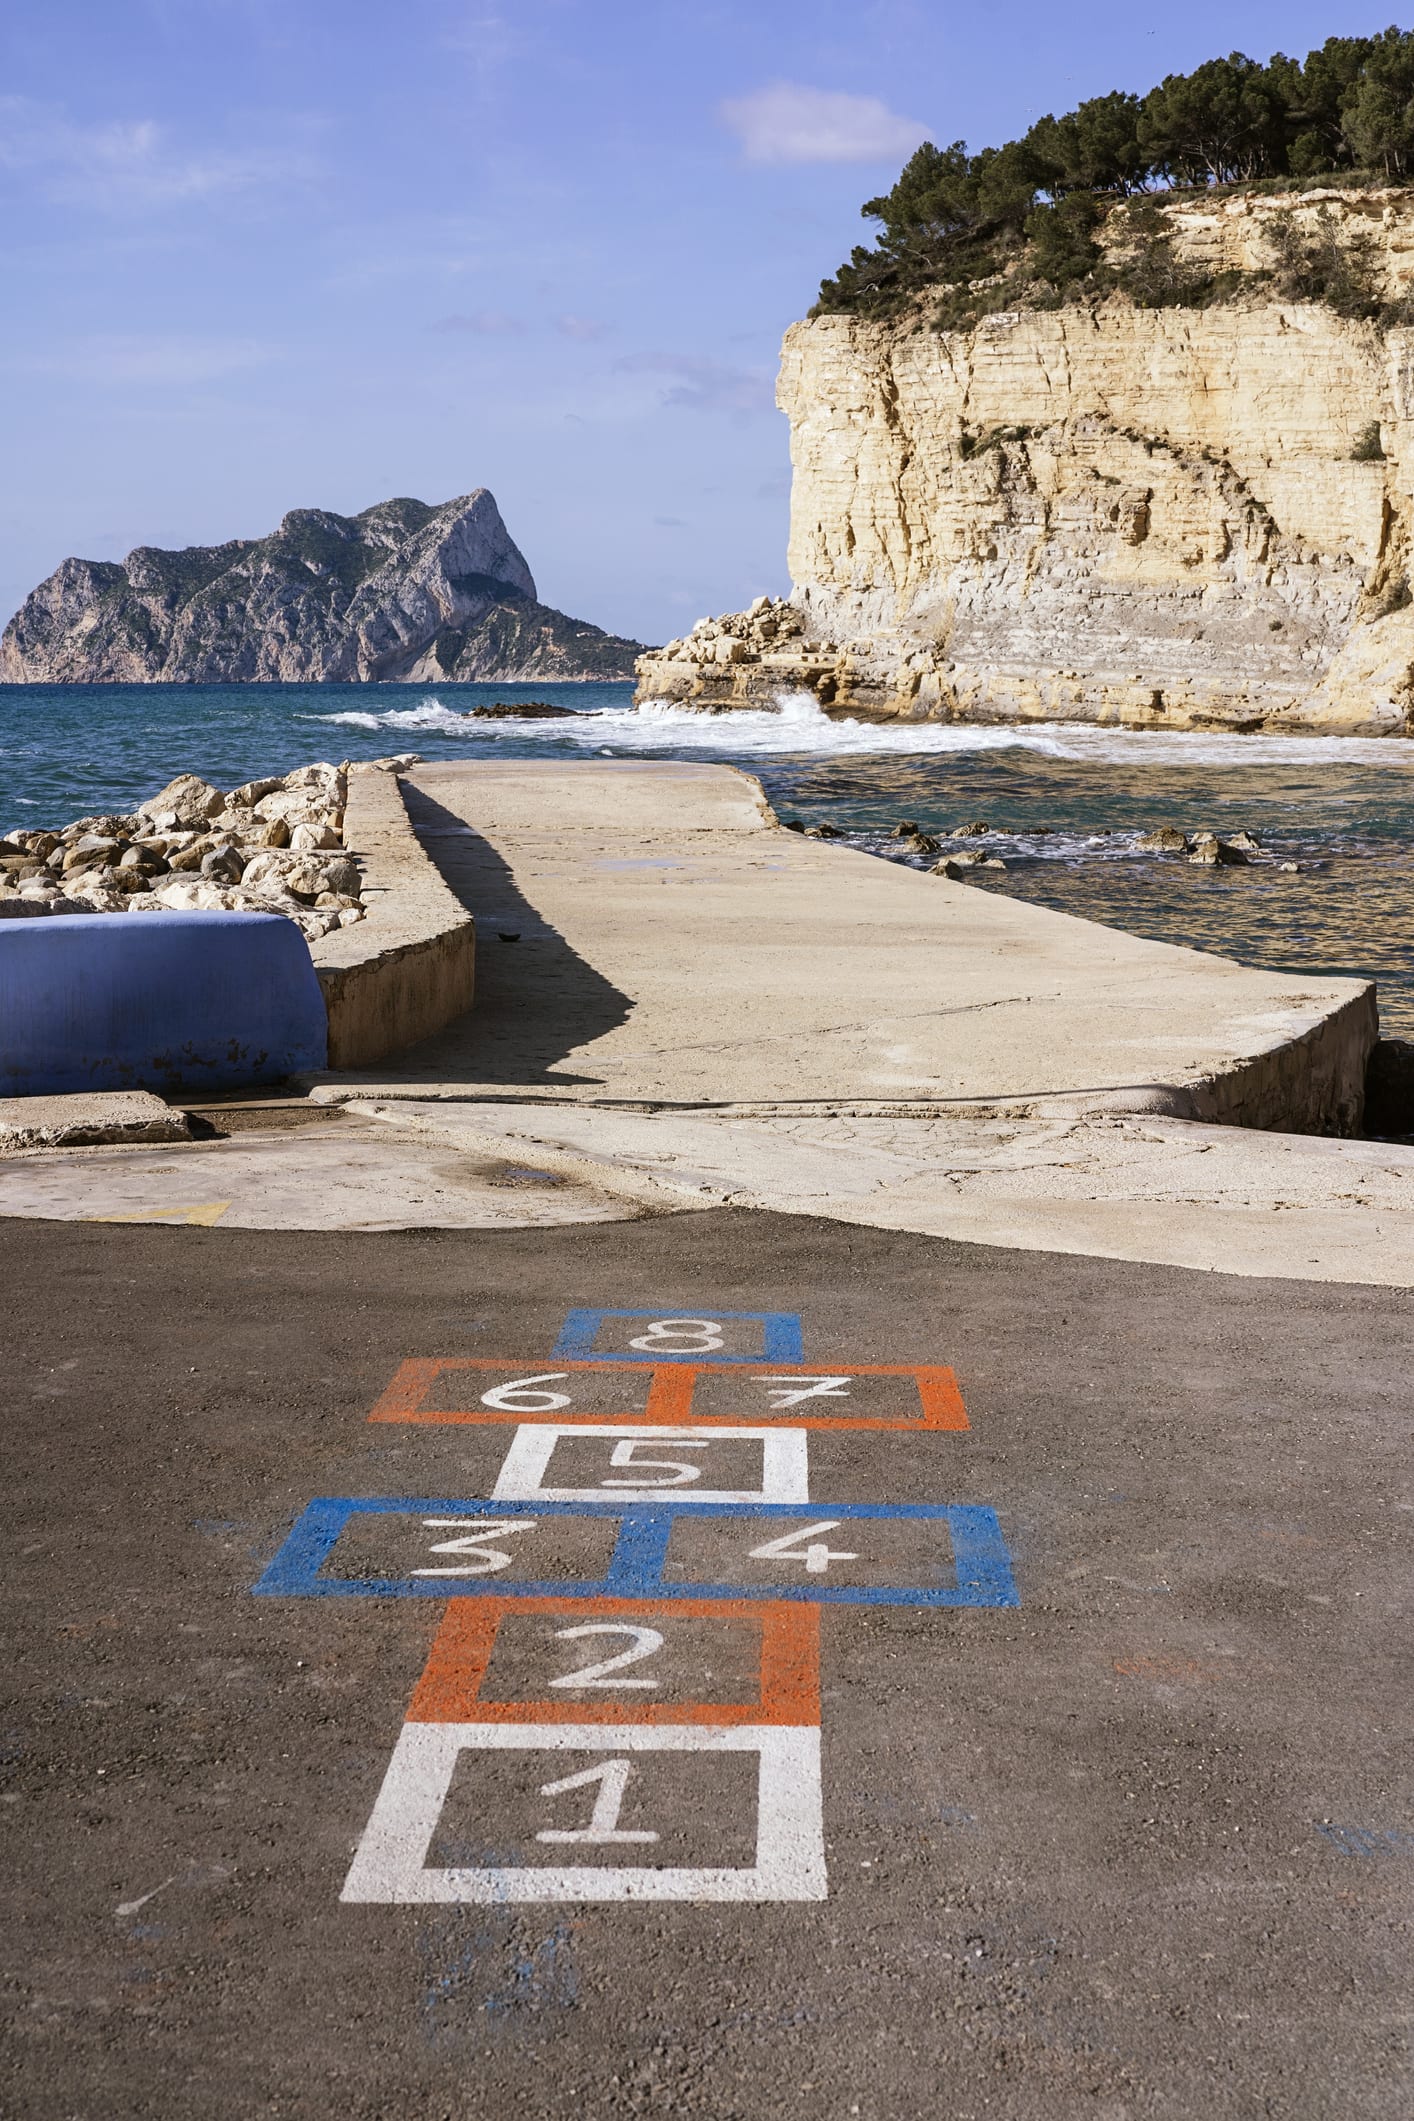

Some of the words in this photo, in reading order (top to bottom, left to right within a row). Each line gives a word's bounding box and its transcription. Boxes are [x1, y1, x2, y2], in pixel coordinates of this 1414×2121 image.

[627, 1317, 725, 1355] 8
[480, 1373, 572, 1413] 6
[750, 1375, 853, 1411] 7
[599, 1438, 711, 1488] 5
[410, 1518, 538, 1576] 3
[748, 1519, 859, 1575] 4
[547, 1621, 665, 1690] 2
[535, 1758, 661, 1844] 1
